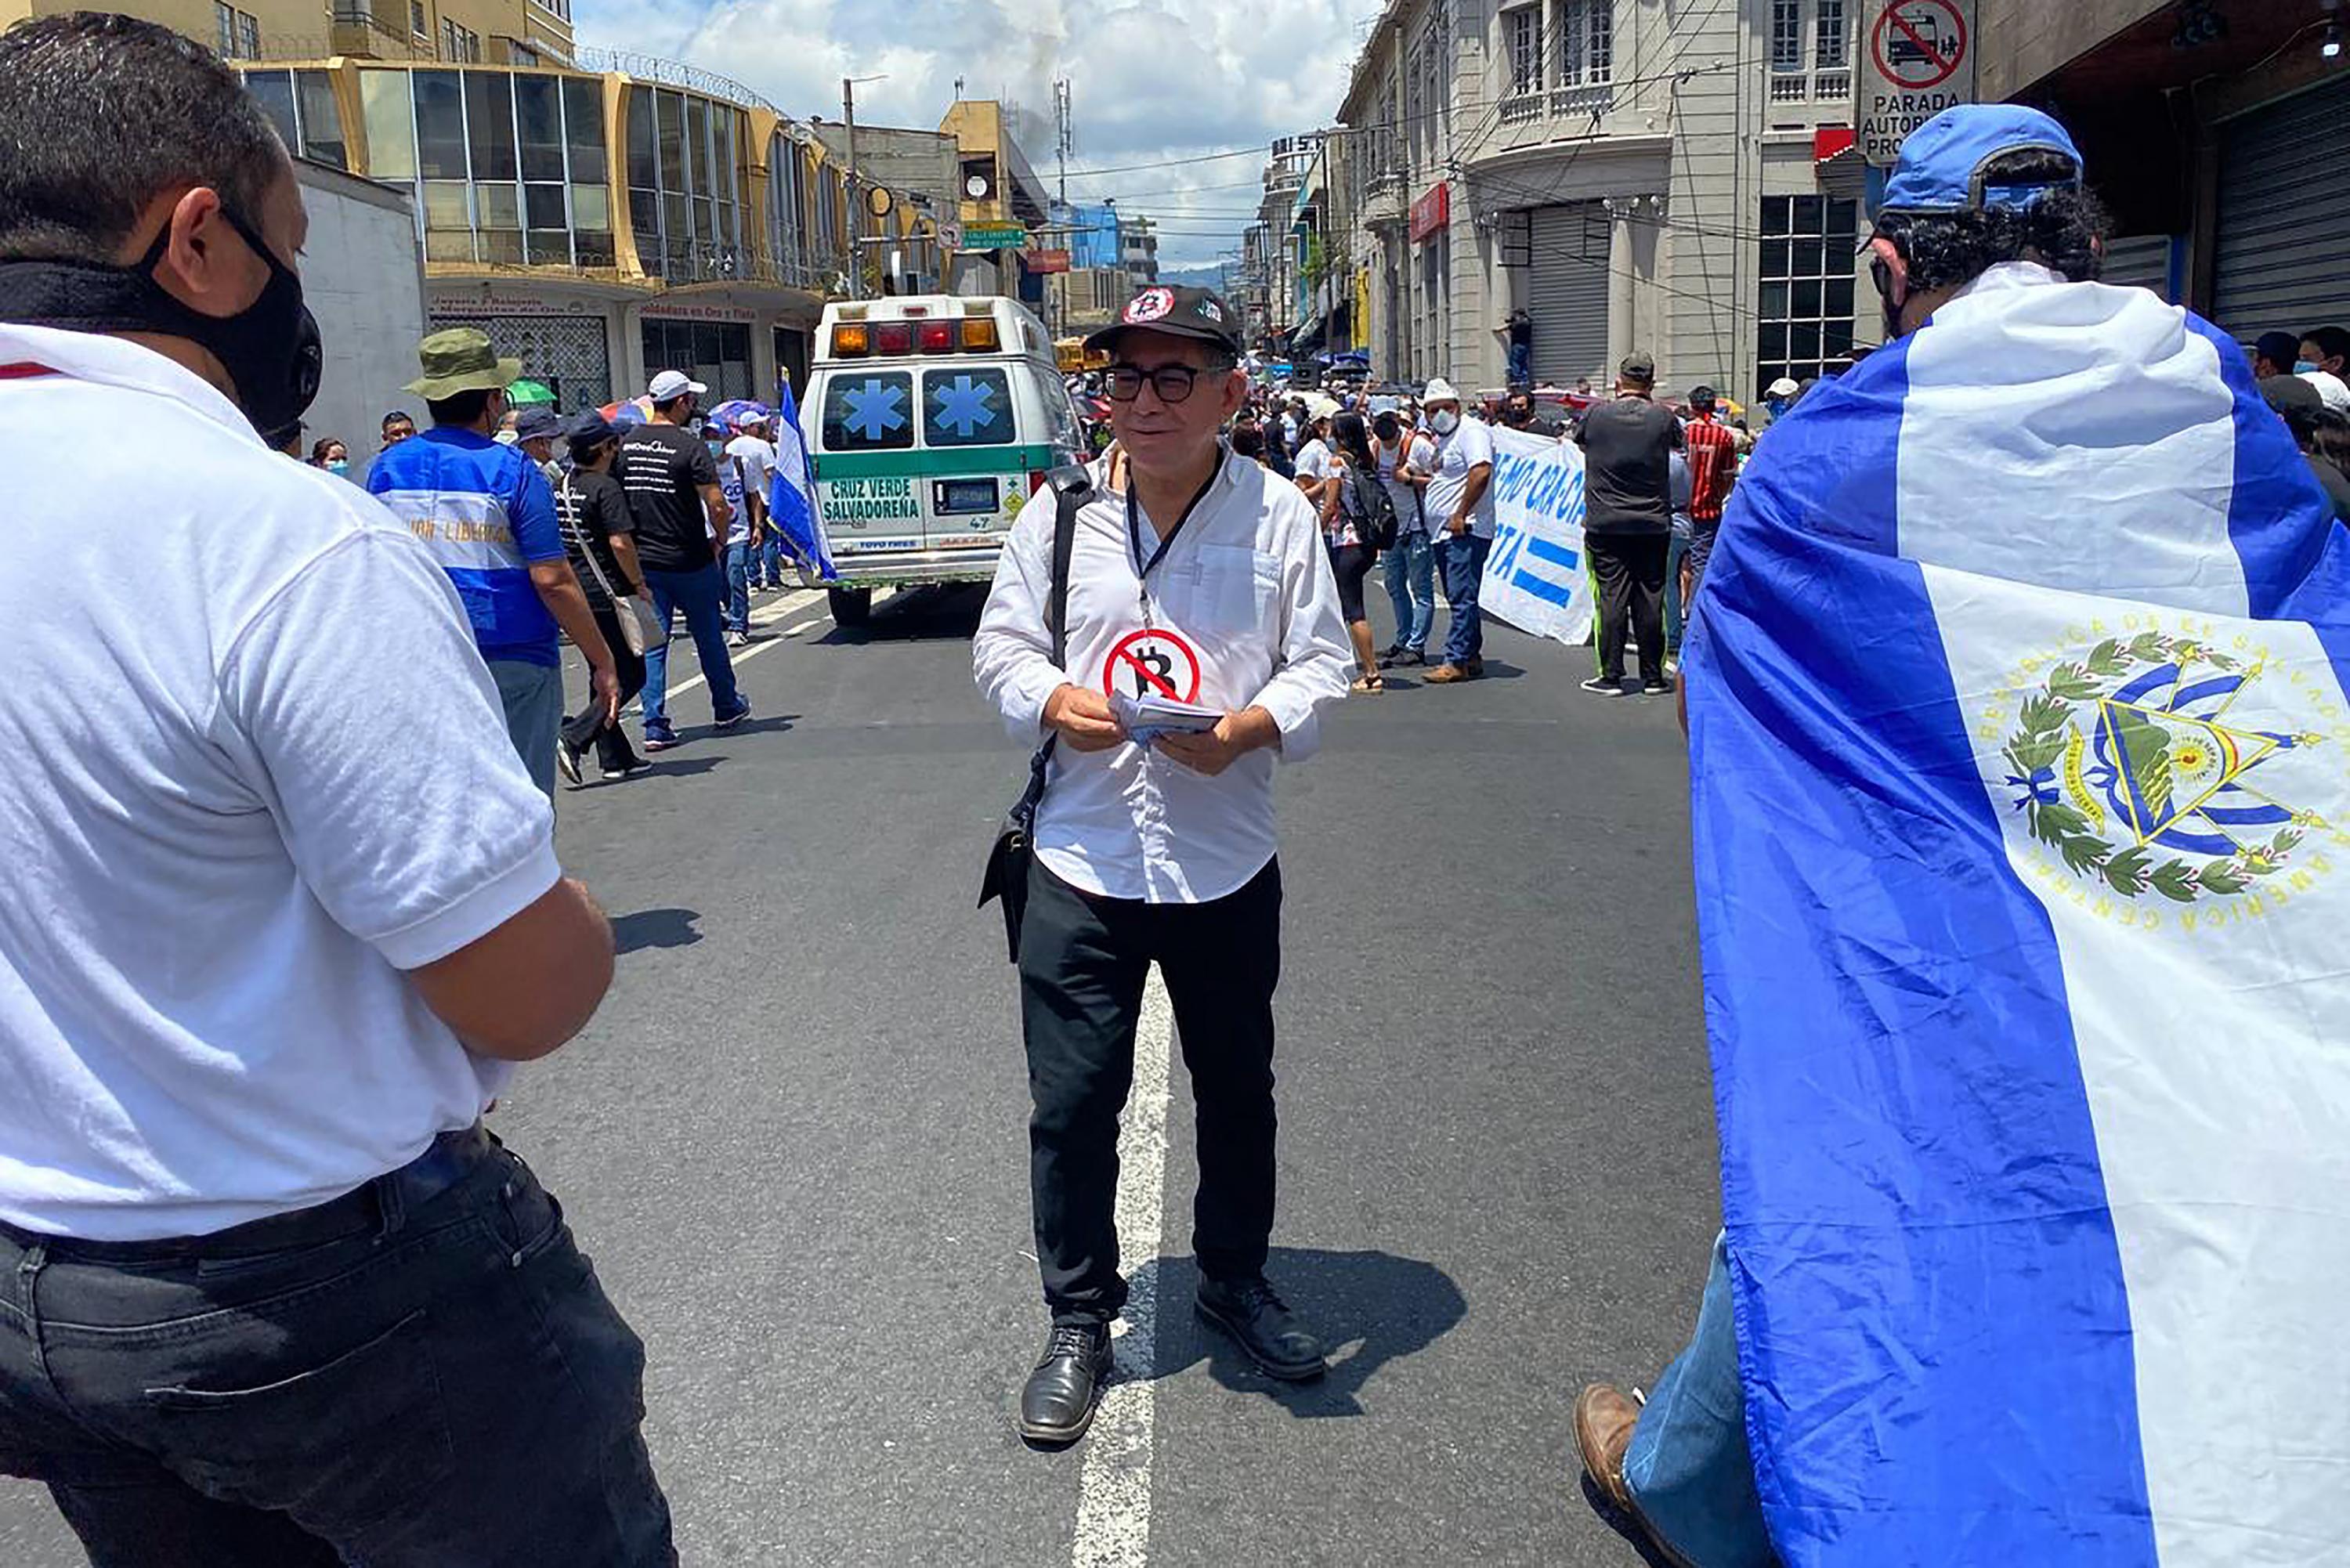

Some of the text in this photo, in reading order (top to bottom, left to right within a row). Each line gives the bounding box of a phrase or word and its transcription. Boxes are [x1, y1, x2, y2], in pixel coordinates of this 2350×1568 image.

[1874, 92, 1959, 113] PARADA
[830, 478, 911, 499] CRUZ VERDE
